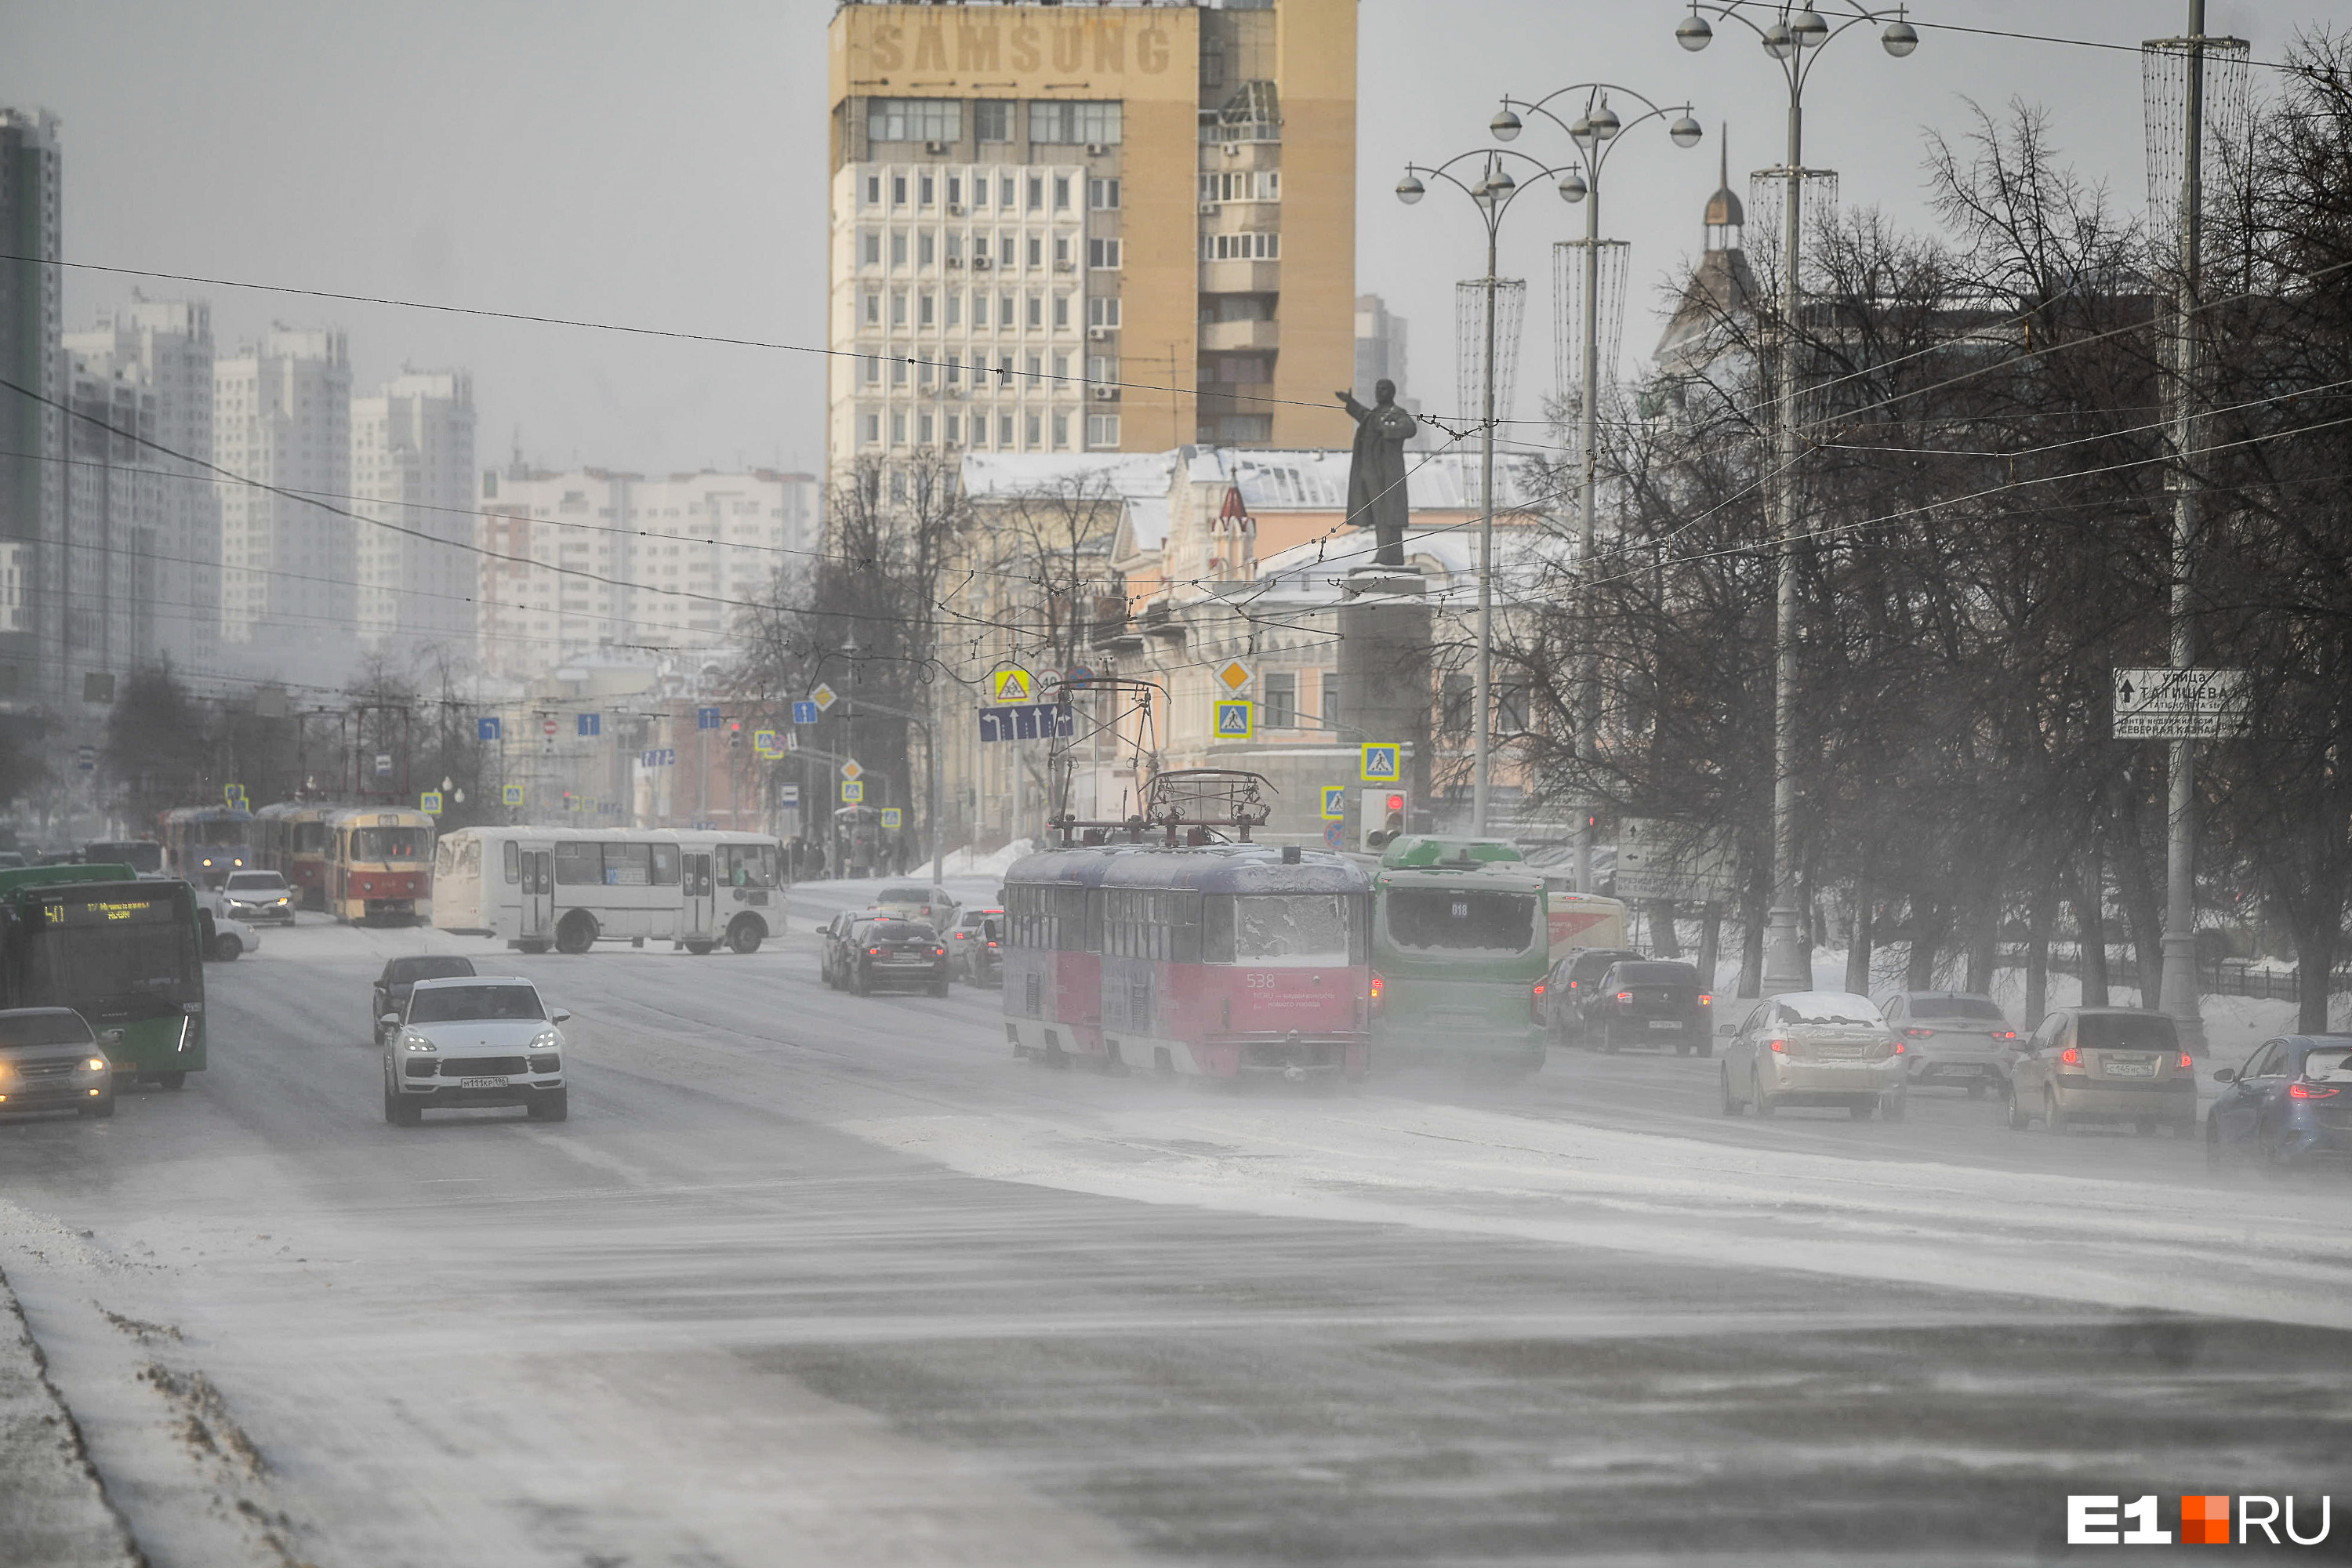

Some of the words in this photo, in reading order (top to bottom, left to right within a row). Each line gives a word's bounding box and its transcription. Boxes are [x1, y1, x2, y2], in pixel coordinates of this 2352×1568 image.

[872, 24, 1169, 74] SAMSUNG
[1043, 677, 1057, 687] 40
[2163, 673, 2205, 684] улица
[1452, 904, 1468, 916] 018
[1247, 973, 1275, 988] 538
